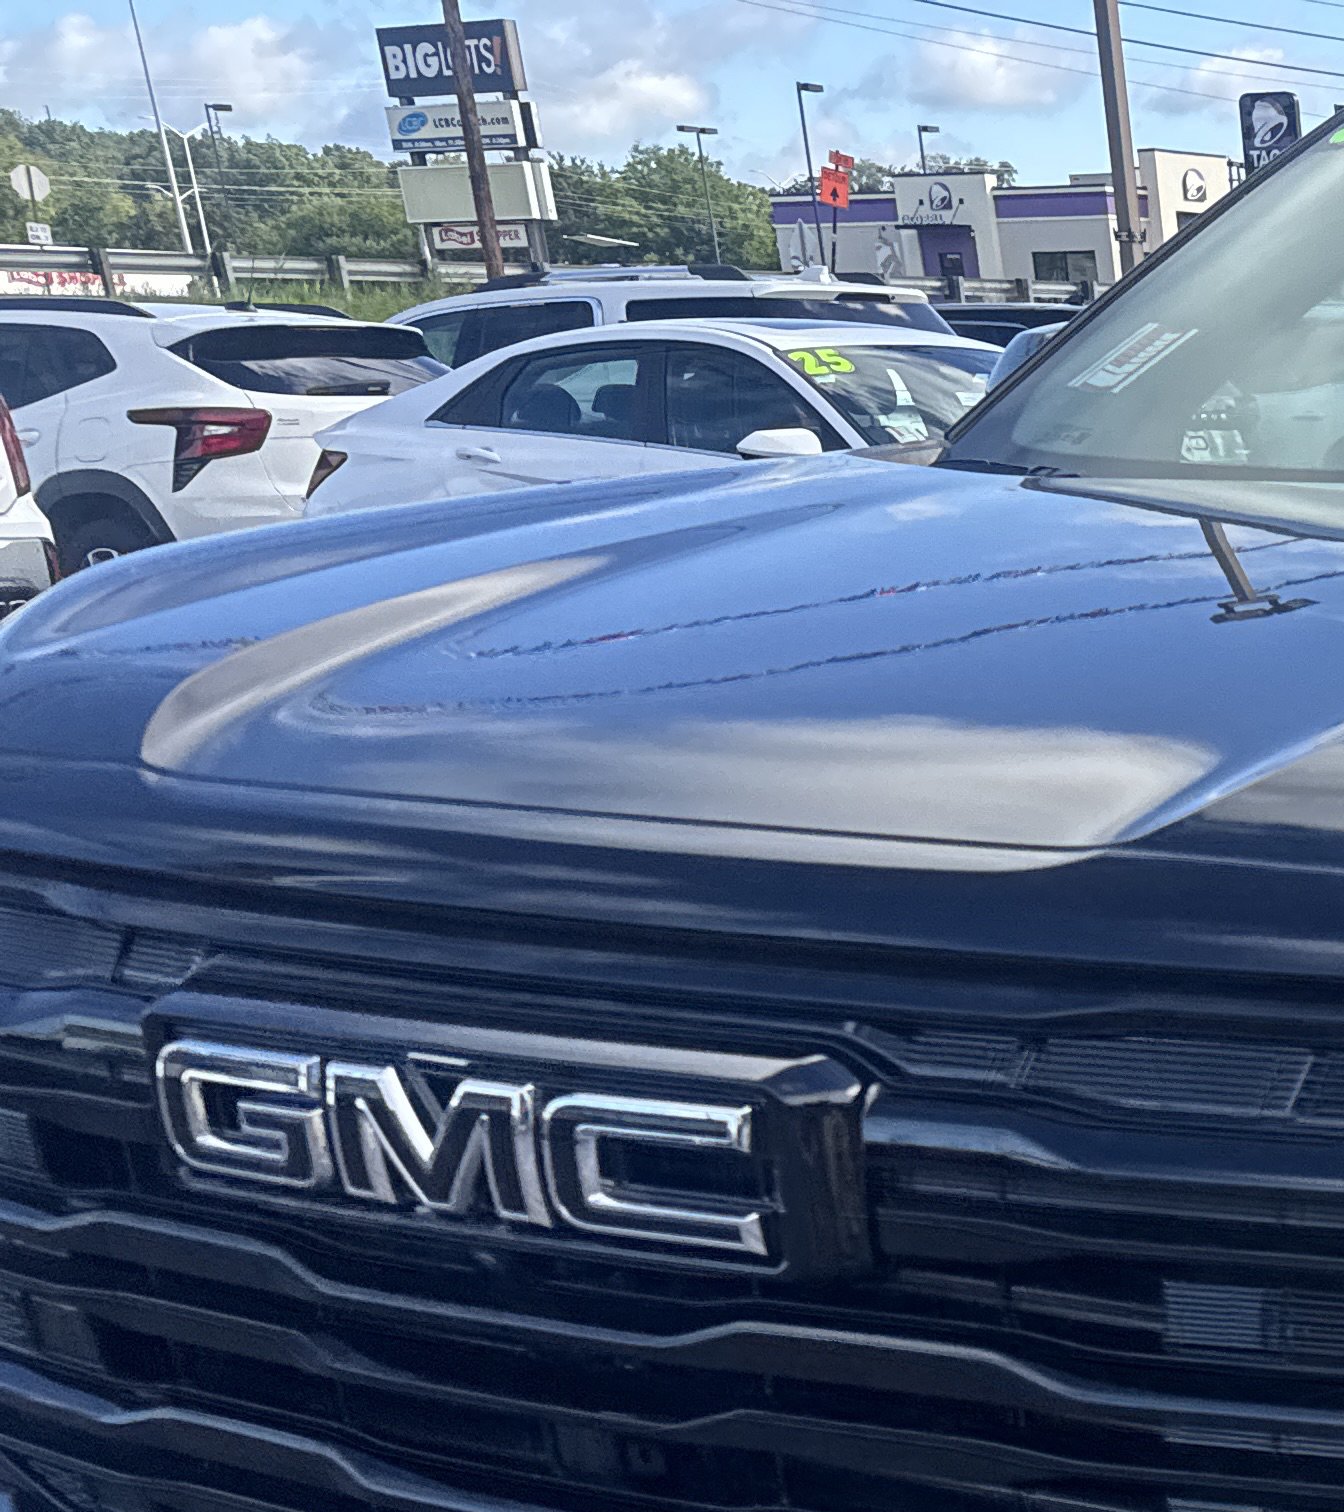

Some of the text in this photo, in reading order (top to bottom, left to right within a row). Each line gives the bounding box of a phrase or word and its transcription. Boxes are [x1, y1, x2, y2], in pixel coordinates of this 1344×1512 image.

[384, 42, 438, 80] BIG
[1249, 149, 1281, 168] TAC
[475, 230, 521, 241] SPPER
[787, 349, 855, 376] 25
[156, 1040, 768, 1256] GMC
